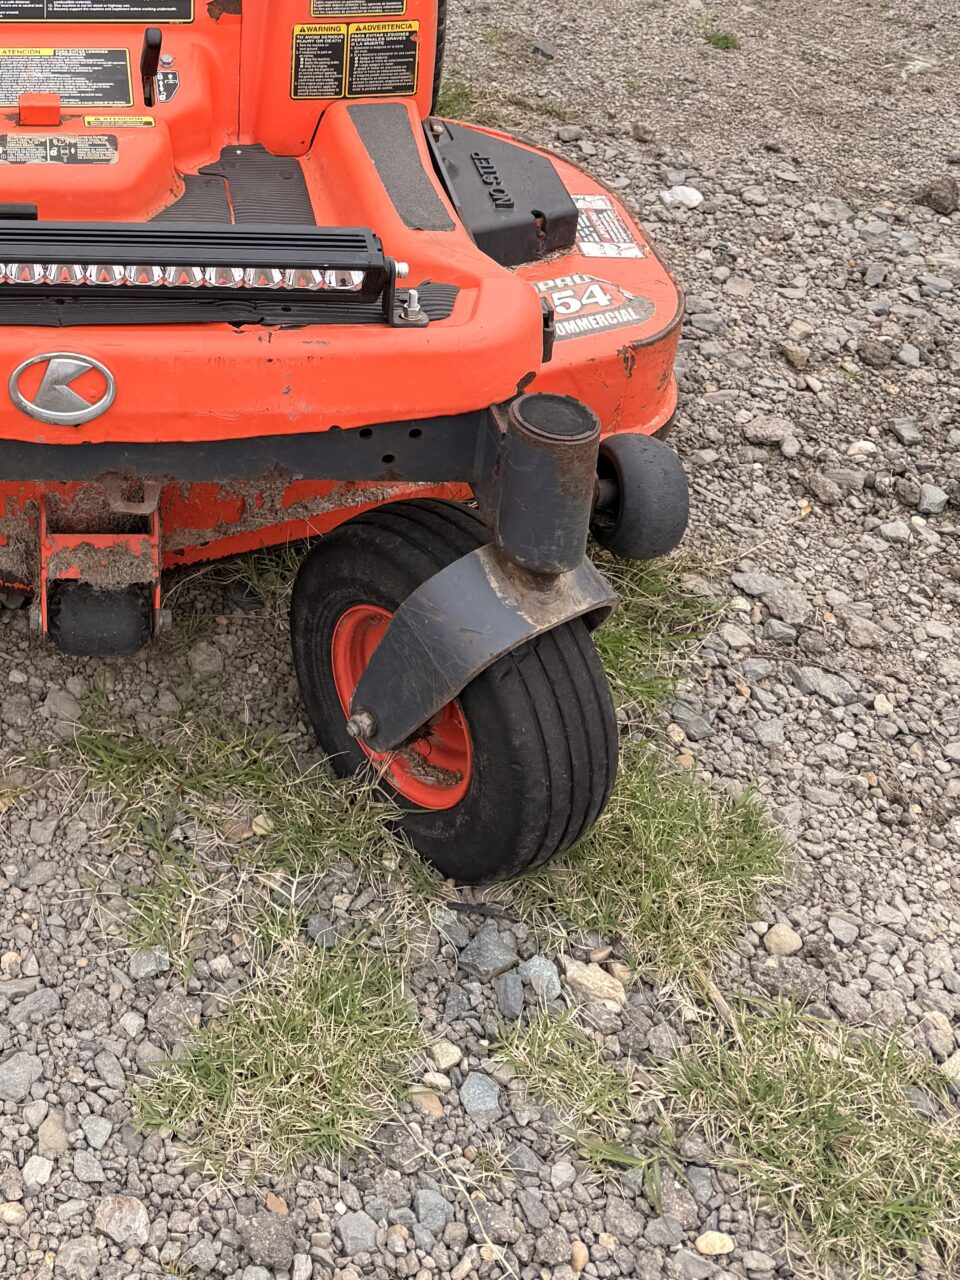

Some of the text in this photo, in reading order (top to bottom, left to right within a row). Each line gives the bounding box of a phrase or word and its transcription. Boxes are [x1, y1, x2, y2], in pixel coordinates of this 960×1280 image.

[470, 151, 515, 209] NO STEP
[551, 284, 612, 314] 54
[555, 307, 640, 336] OMMERCIAL
